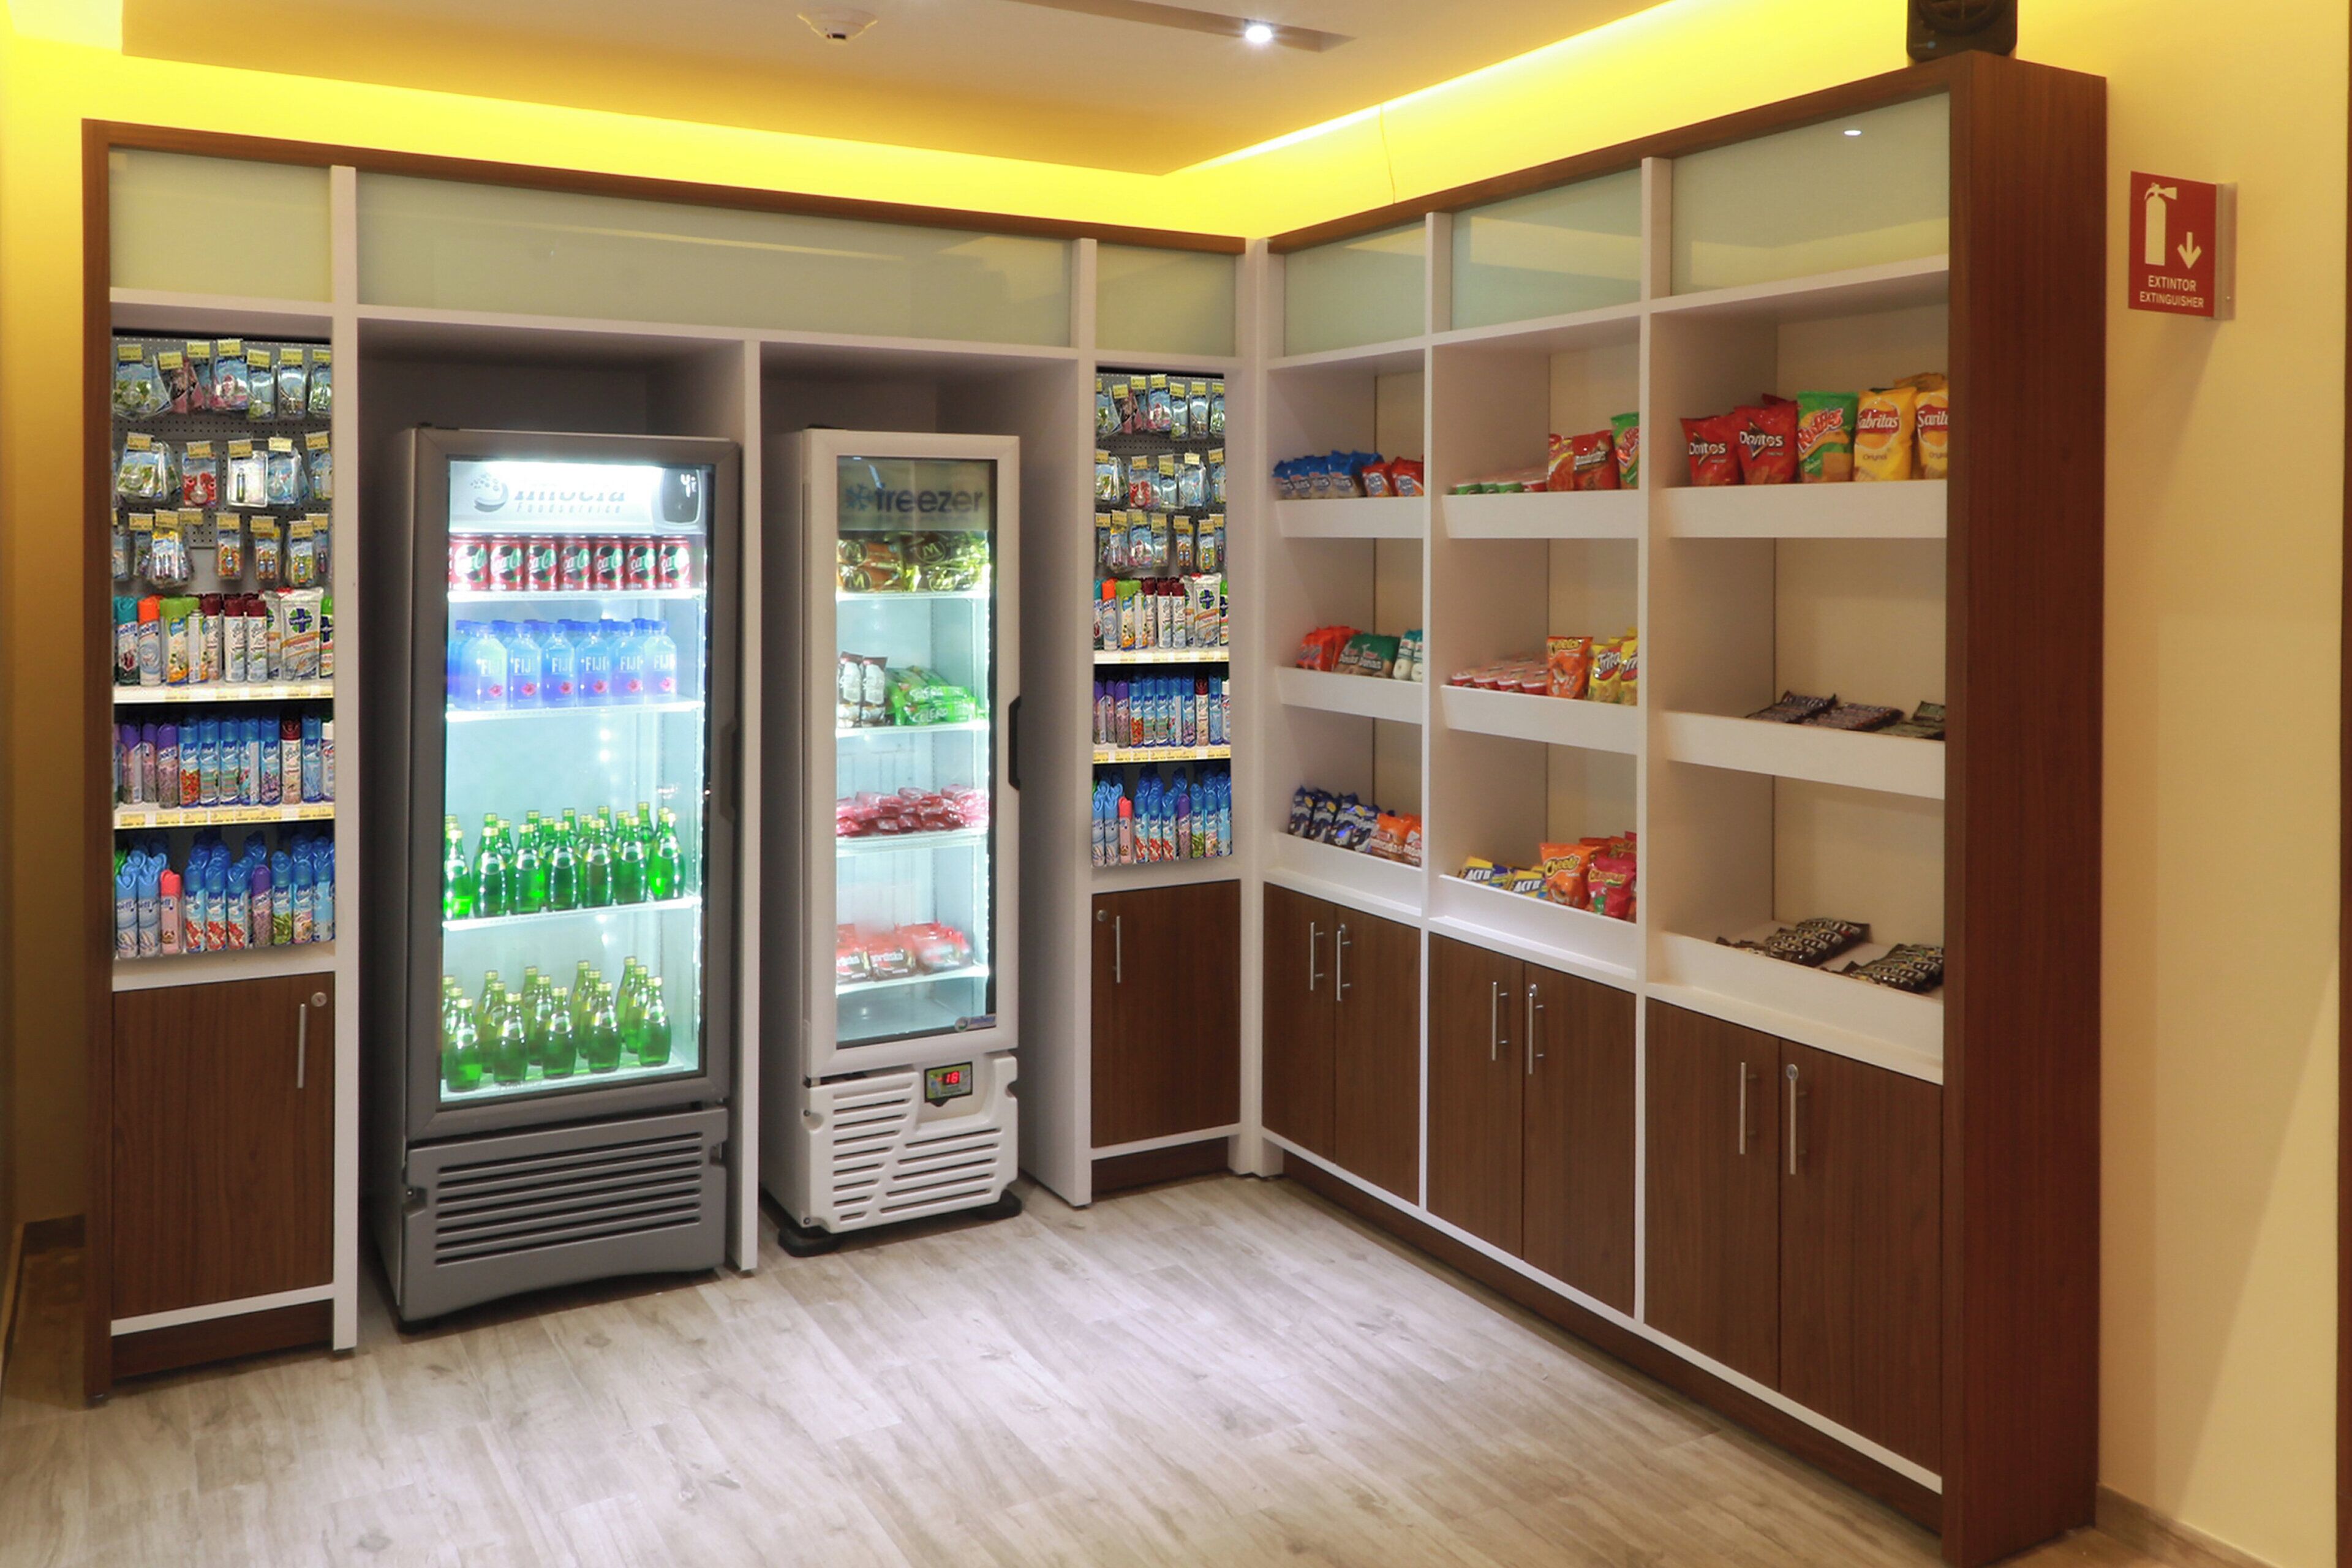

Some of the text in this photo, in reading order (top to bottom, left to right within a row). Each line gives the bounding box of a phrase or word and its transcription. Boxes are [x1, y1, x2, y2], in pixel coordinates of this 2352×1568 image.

[2147, 275, 2196, 292] EXTINTOR
[2139, 291, 2204, 308] EXTINGUISHER
[1740, 431, 1784, 447] Doritos
[1689, 442, 1726, 456] Doritos
[874, 483, 983, 513] freezer
[586, 656, 606, 672] FIJI
[620, 656, 641, 671] FIJI
[1463, 869, 1483, 881] ACT
[1544, 856, 1580, 878] Cheetos
[1512, 881, 1532, 892] ACT
